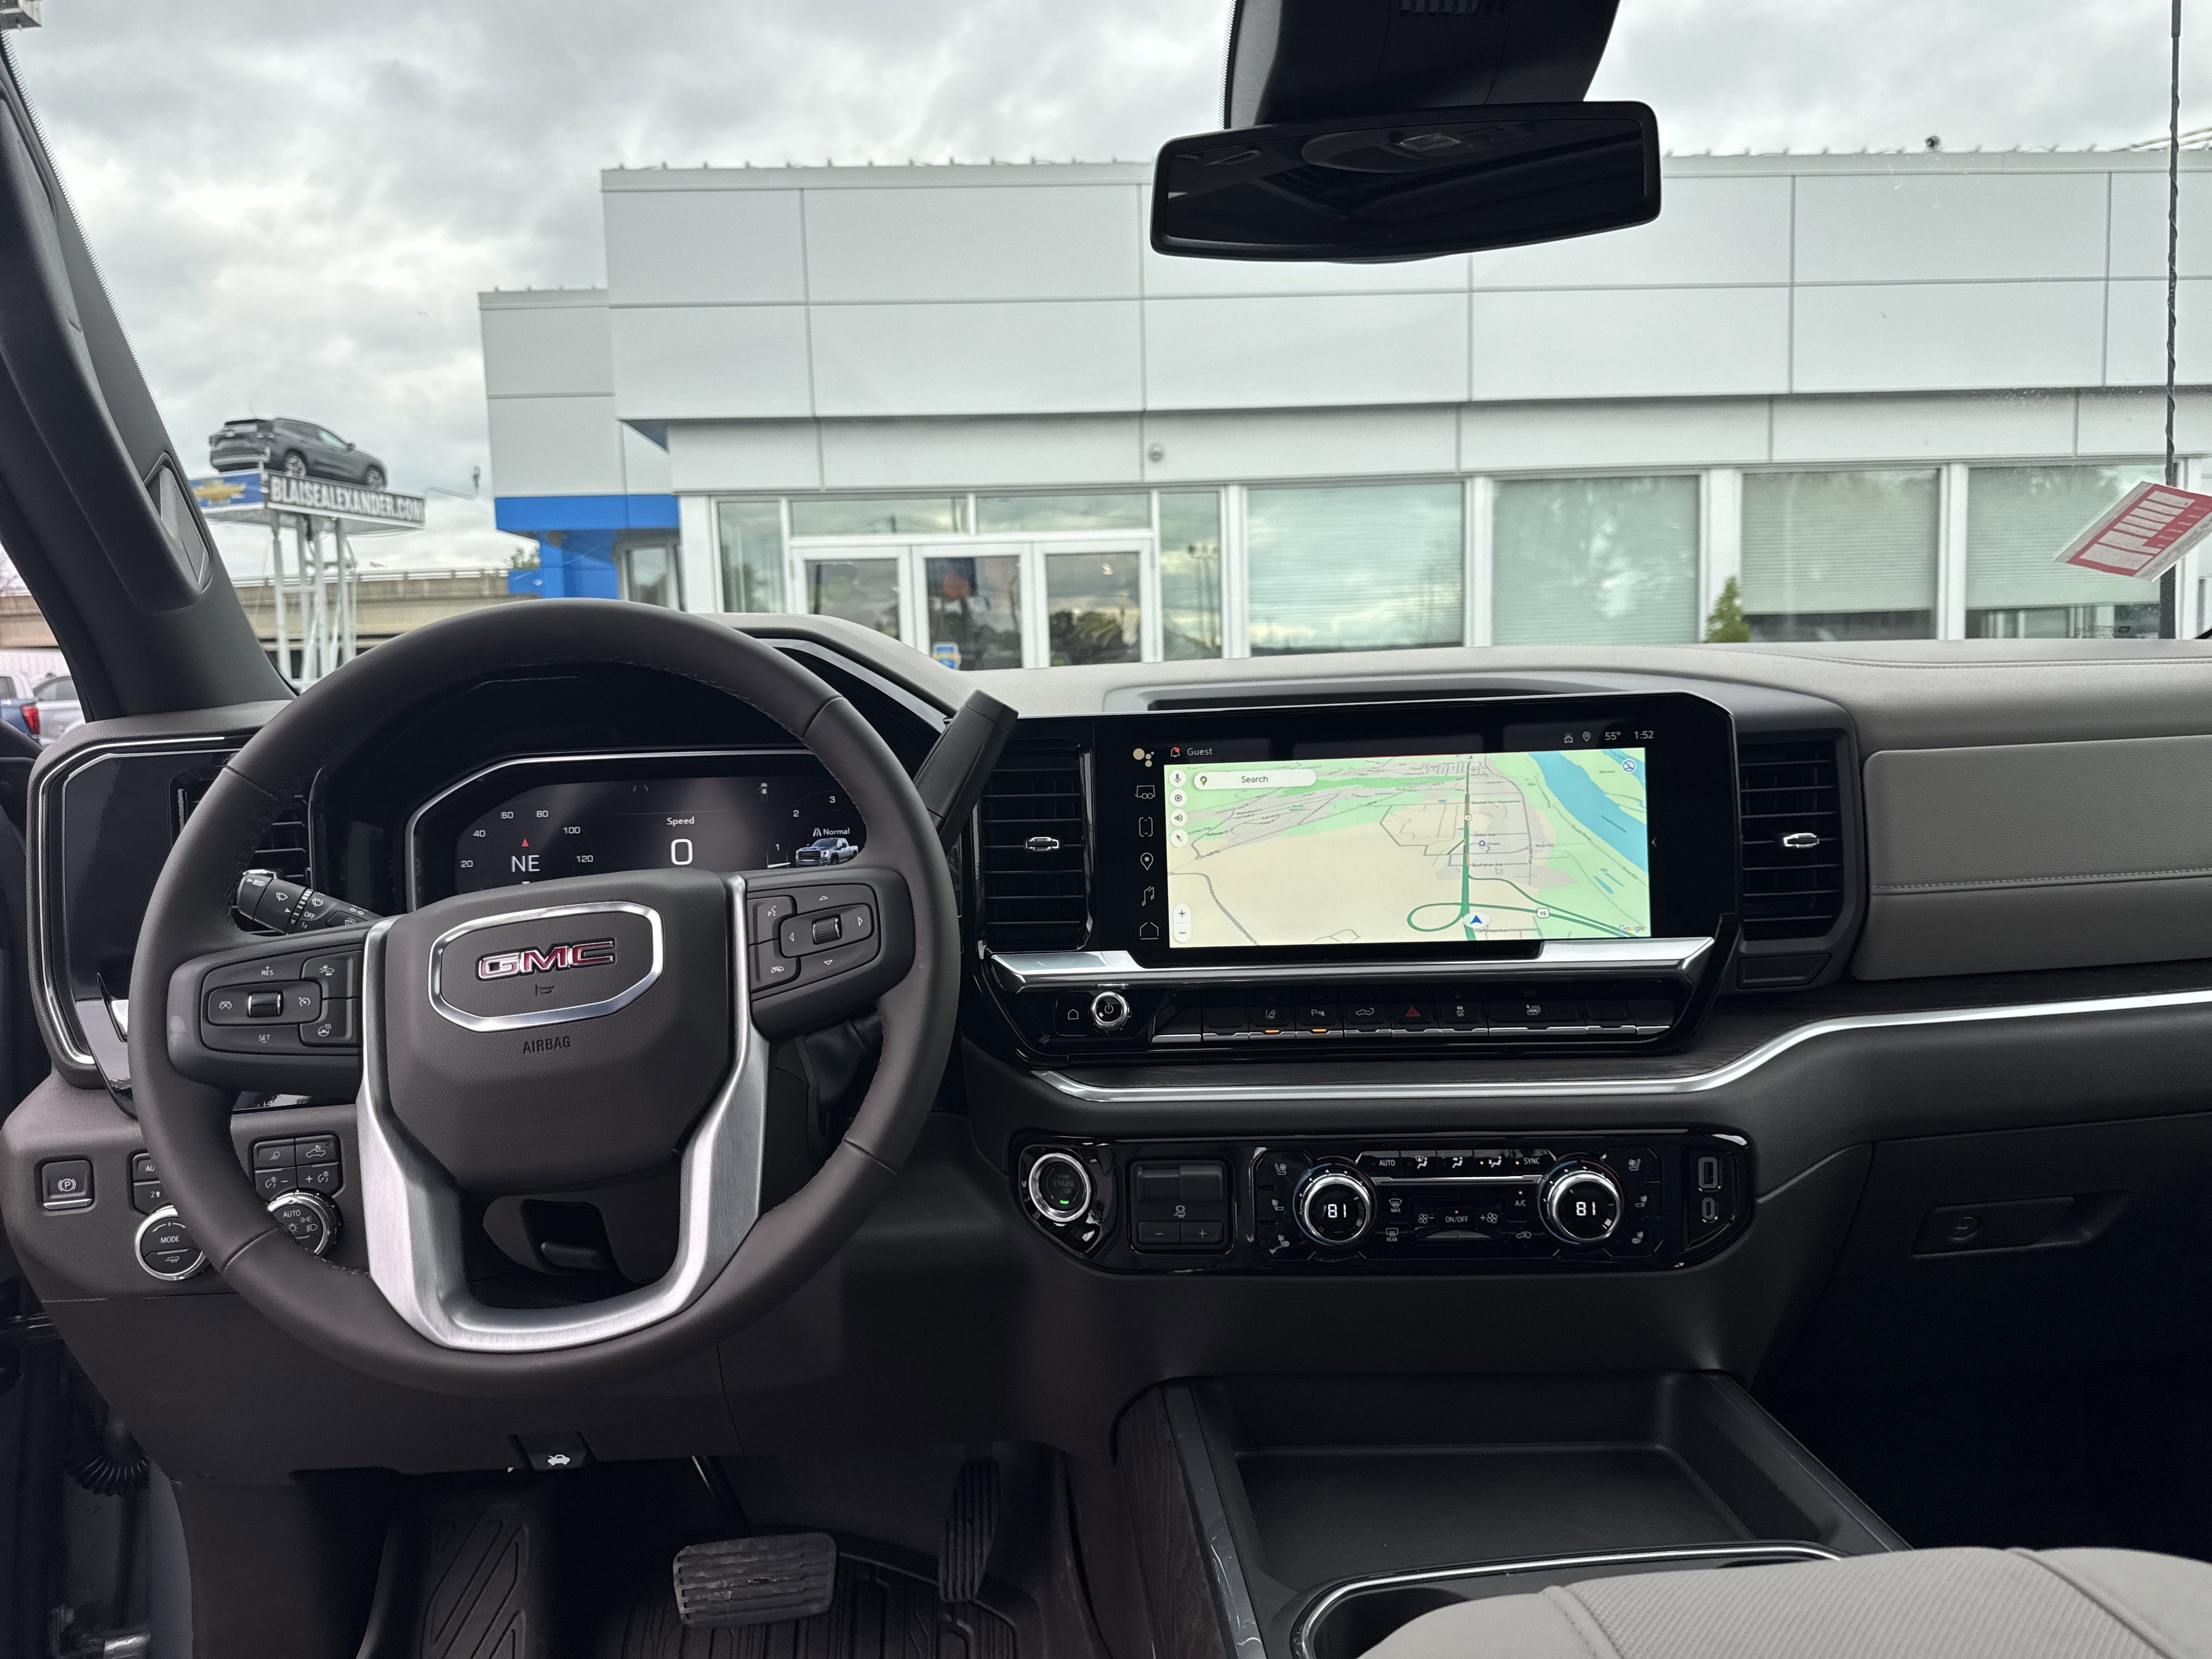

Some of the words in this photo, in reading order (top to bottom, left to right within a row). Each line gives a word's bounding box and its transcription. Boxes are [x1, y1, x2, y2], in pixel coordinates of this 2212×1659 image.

[1634, 731, 1654, 740] 1:52
[1187, 747, 1213, 756] Guest
[1241, 775, 1268, 783] Search
[667, 816, 695, 827] Speed
[670, 838, 694, 866] 0
[511, 854, 540, 872] NE
[304, 911, 316, 919] OFF
[1619, 924, 1646, 933] Google
[478, 940, 615, 980] GMC
[523, 1036, 571, 1054] AIRBAG
[1053, 1180, 1075, 1188] ENGINE
[283, 1209, 301, 1218] AUTO
[1328, 1204, 1347, 1218] 81
[1576, 1201, 1596, 1216] 81
